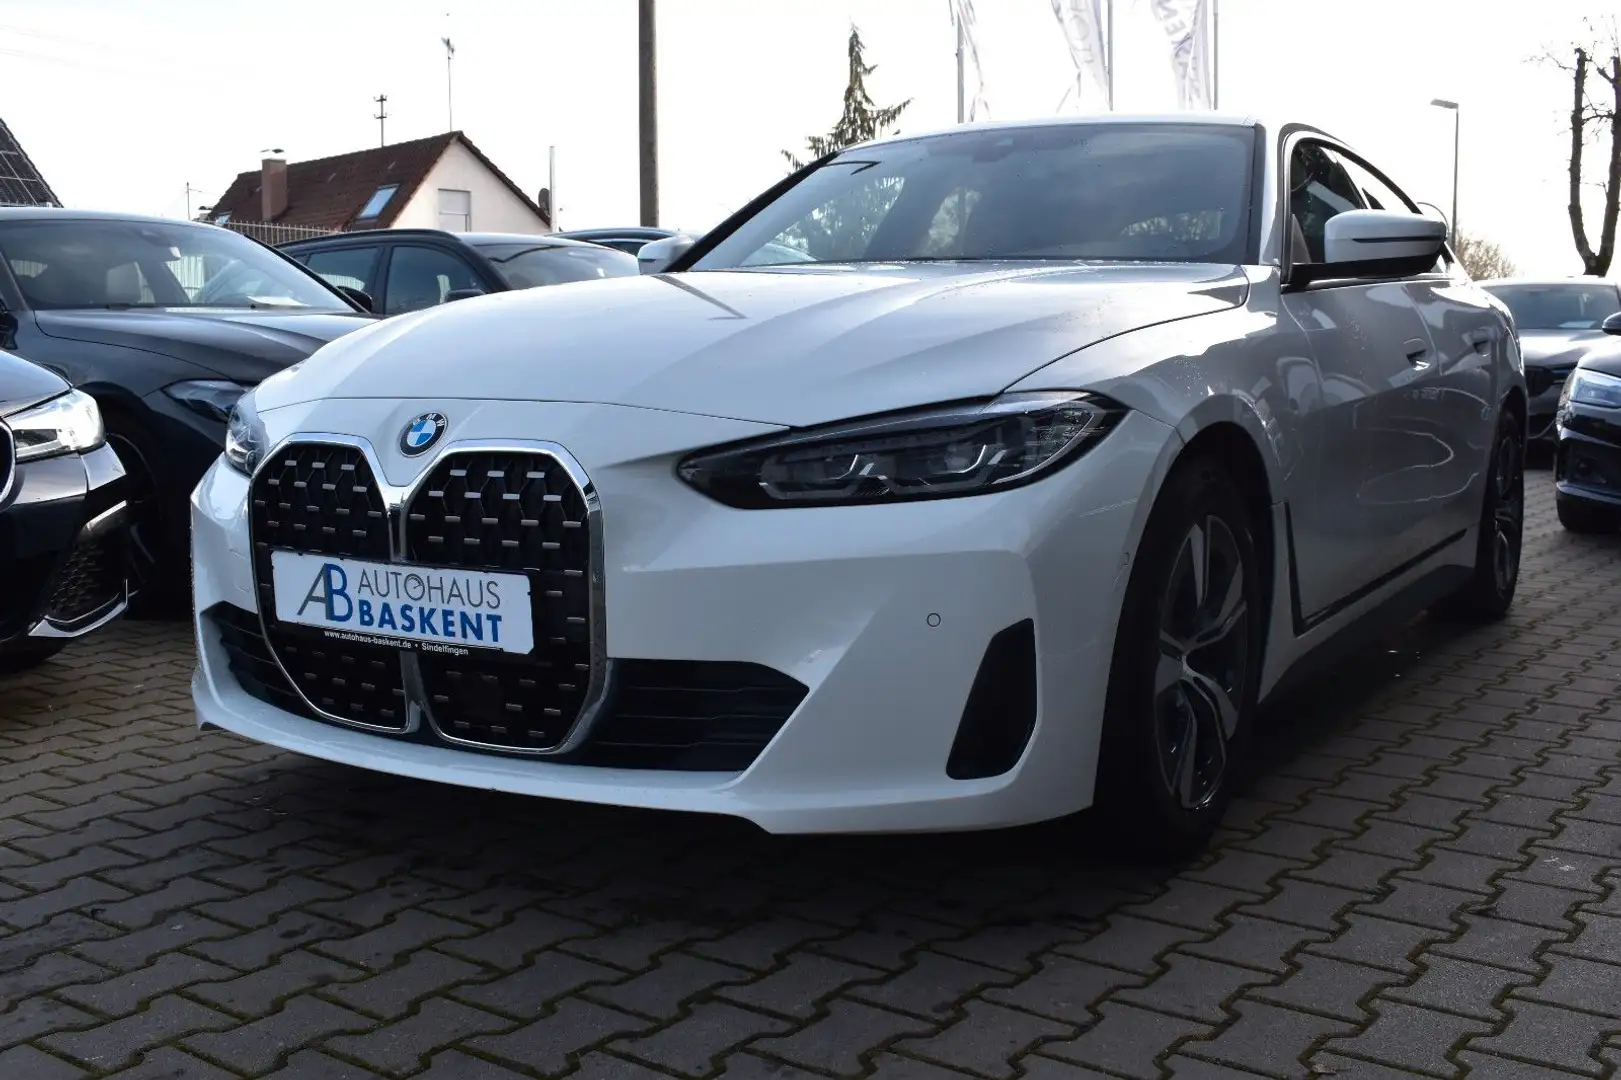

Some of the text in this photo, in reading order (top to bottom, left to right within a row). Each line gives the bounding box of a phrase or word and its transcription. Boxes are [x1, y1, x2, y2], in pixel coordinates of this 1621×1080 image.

[297, 563, 353, 622] AB
[357, 569, 501, 609] AUTOHAUS
[359, 599, 502, 642] BASKENT
[324, 630, 469, 656] www.autohaus-baskent.de Sindelfingen
